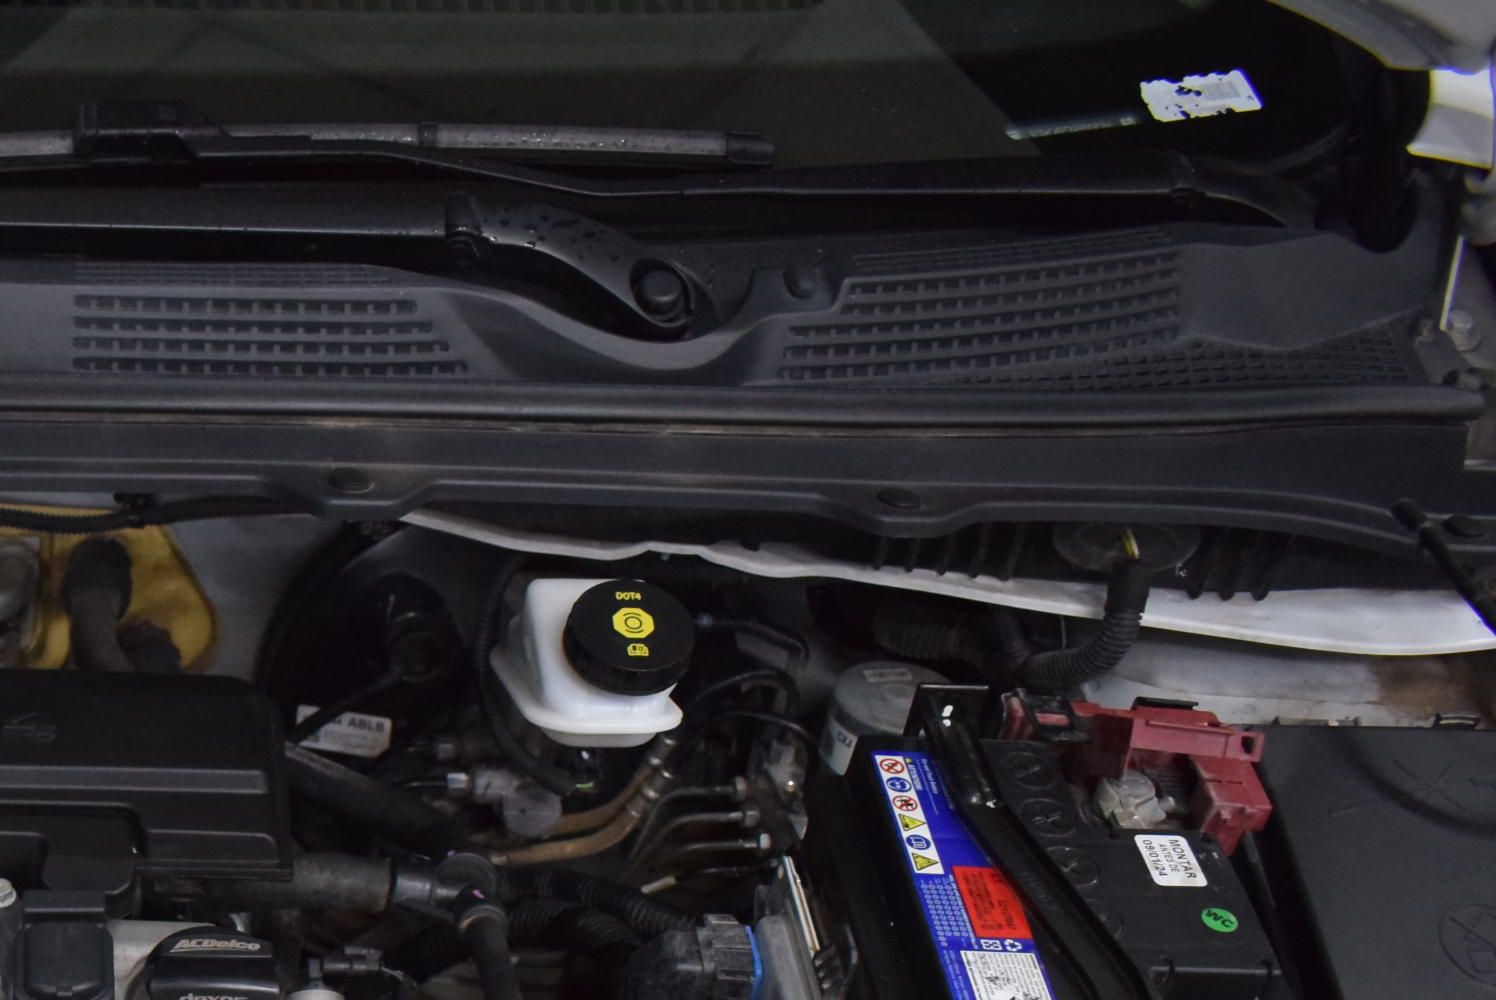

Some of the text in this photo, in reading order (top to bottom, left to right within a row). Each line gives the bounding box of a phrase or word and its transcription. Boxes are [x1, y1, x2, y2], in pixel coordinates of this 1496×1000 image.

[615, 591, 642, 601] DOT4
[1142, 839, 1168, 876] 09/01/24
[1159, 843, 1180, 872] ANTES DE
[1168, 839, 1197, 878] MONTAR
[1206, 909, 1234, 928] WC
[170, 938, 262, 952] ACDelco
